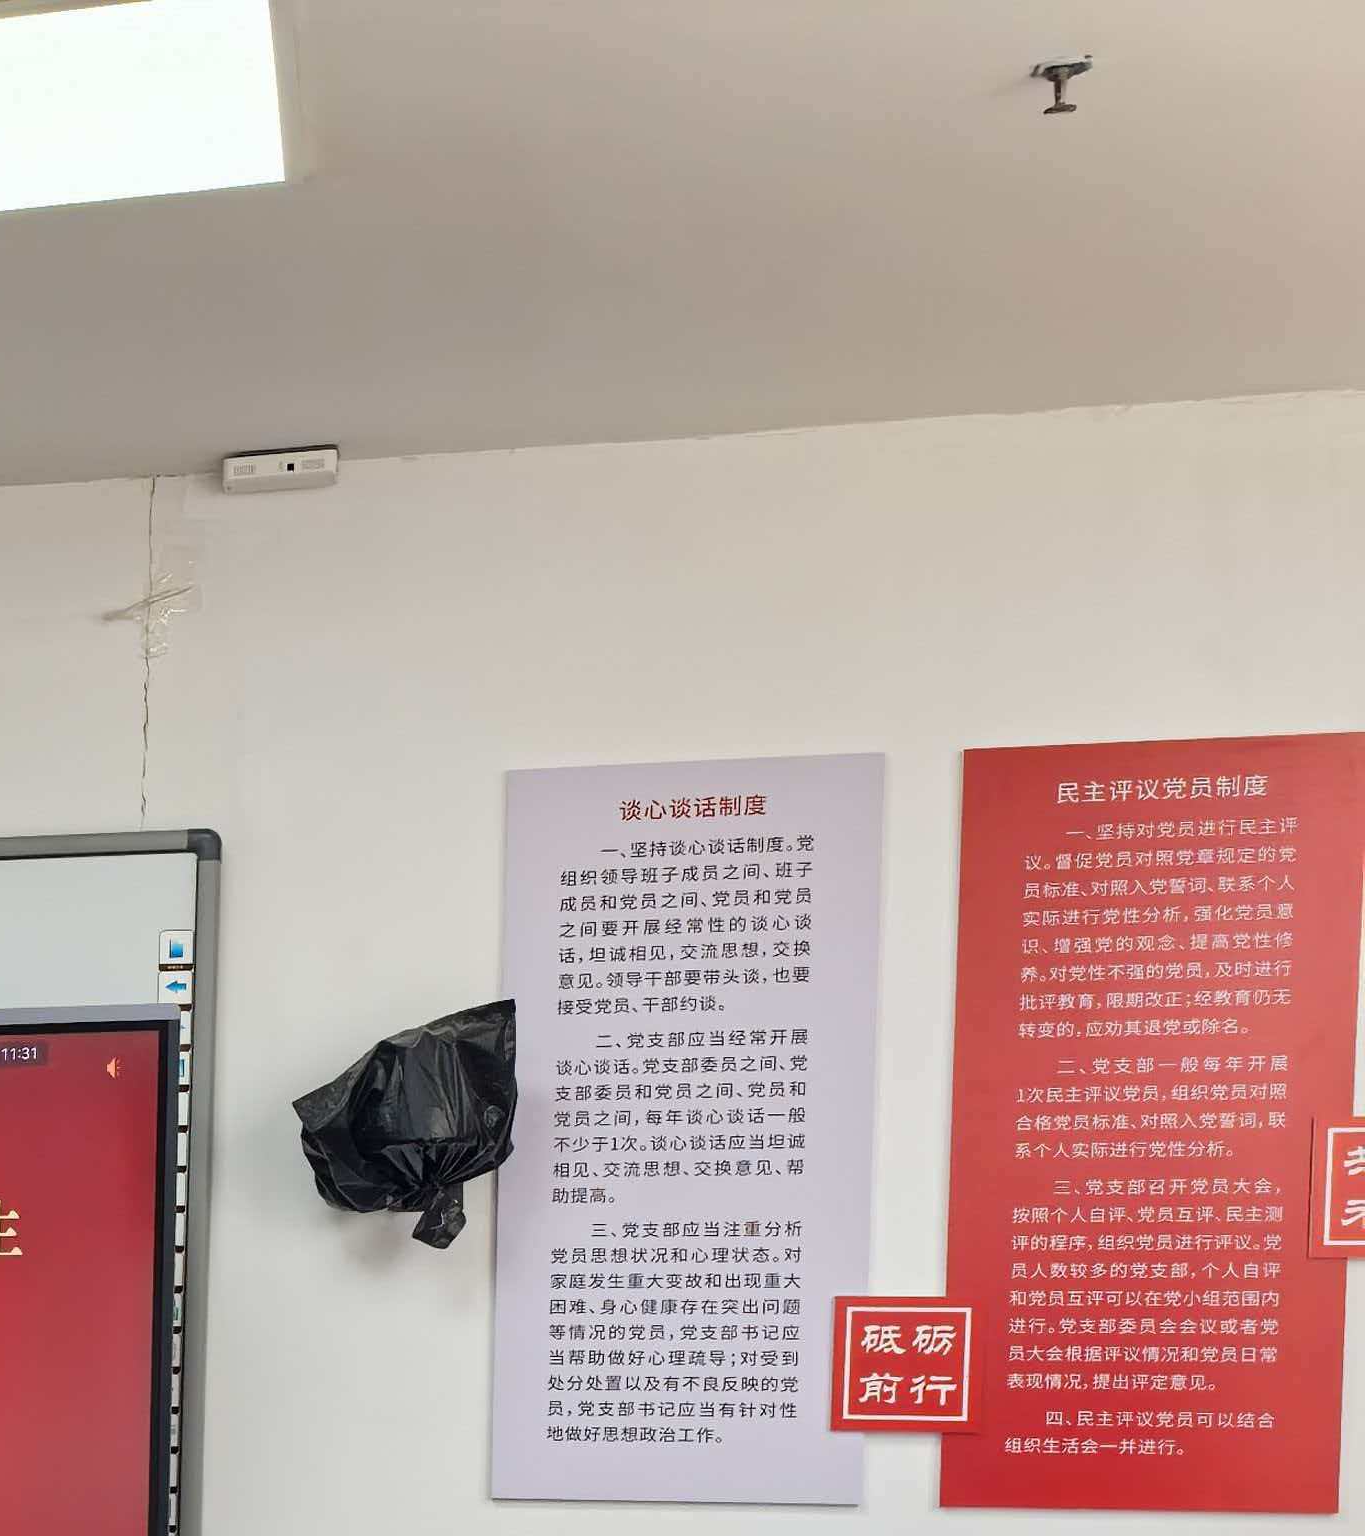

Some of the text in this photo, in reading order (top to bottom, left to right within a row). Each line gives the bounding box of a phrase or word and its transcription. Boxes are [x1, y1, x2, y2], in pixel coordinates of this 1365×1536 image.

[1056, 773, 1270, 805] 民主评议党员制度
[618, 792, 768, 822] 谈心谈话制度
[1065, 815, 1298, 841] 一、坚持对党员进行民主评
[600, 834, 815, 859] 一、坚持谈心谈话制度。党
[560, 861, 813, 888] 组织领导班子成员之间、班子
[558, 887, 814, 913] 成员和党员之间、党员和党员
[558, 912, 812, 939] 之间要开展经常性的谈心谈
[557, 994, 725, 1016] 接受党员、干部约谈。
[595, 1028, 810, 1049] 二、党支部应当经常开展
[1, 1047, 37, 1061] 11:31
[1057, 1054, 1289, 1075] 二、党支部一般每年开展
[555, 1054, 809, 1077] 谈心谈话。党支部委员之间、党
[554, 1080, 807, 1104] 支部委员和党员之间、党员和
[553, 1132, 806, 1153] 不少于1次。谈心谈话应当坦诚
[1014, 1140, 1234, 1161] 系个人实际进行党性分析。
[552, 1158, 805, 1179] 相见、交流思想、交换意见、帮
[551, 1185, 615, 1205] 助提高。
[1011, 1205, 1284, 1225] 按照个人自评、党员互评、民主测
[590, 1219, 803, 1240] 三、党支部应当注重分析
[550, 1245, 803, 1265] 党员思想状况和心理状态。对
[549, 1271, 802, 1290] 家庭发生重大变故和出现重大
[548, 1296, 801, 1320] 困难、身心健康存在突出问题
[1008, 1288, 1280, 1308] 和党员互评可以在党小组范围内
[1008, 1316, 1280, 1337] 进行。党支部委员会会议或者党
[860, 1324, 956, 1356] 砥砺
[1007, 1344, 1278, 1364] 员大会根据评议情况和党员日常
[546, 1373, 800, 1394] 处分处置以及有不良反映的党
[858, 1372, 957, 1406] 前行
[1045, 1407, 1277, 1429] 四、民主评议党员可以结合
[546, 1423, 723, 1445] 地做好思想政治工作。
[1004, 1435, 1185, 1457] 组织生活会一并进行。
